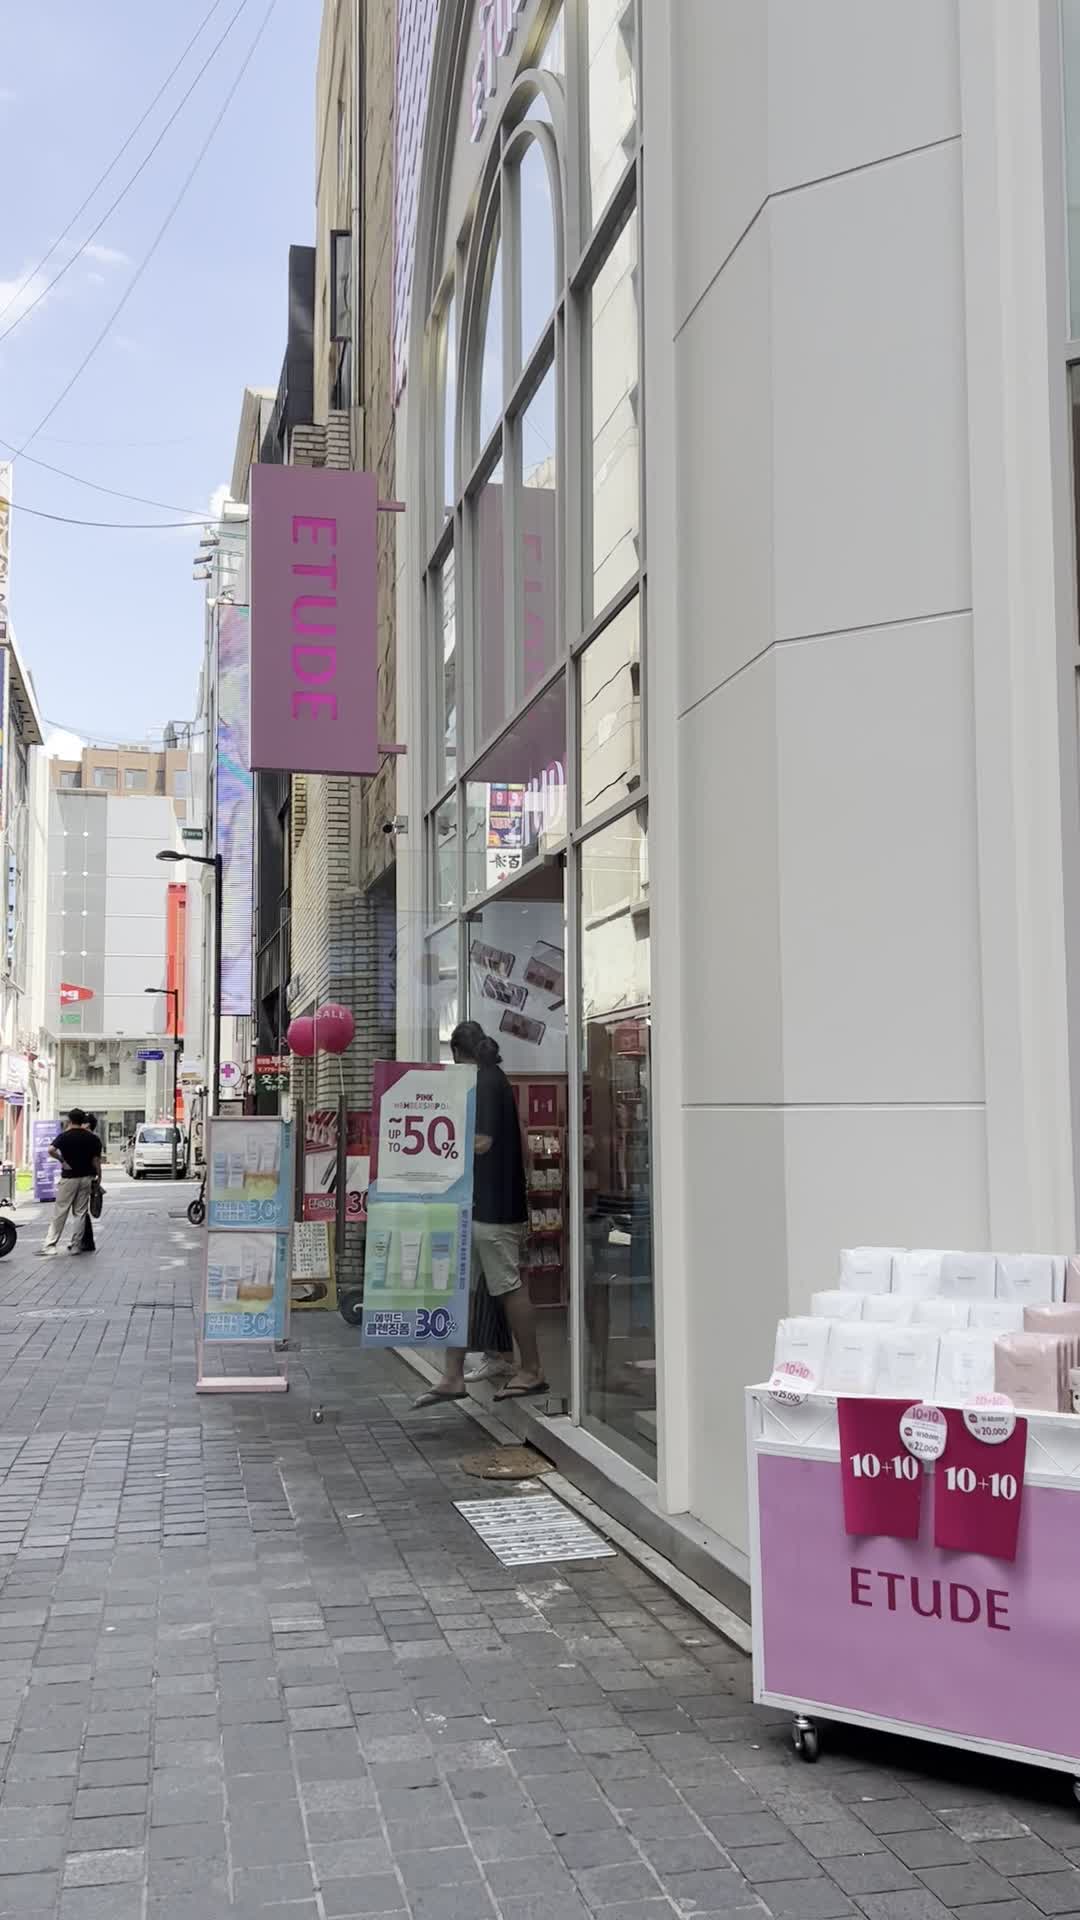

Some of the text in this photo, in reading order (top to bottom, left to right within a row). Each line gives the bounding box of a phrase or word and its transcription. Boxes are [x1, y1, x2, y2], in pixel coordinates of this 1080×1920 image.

[292, 515, 337, 720] ETUDE
[388, 1130, 401, 1139] UP
[388, 1142, 401, 1152] TO
[415, 1307, 457, 1338] 30%
[850, 1453, 919, 1481] 10+10
[943, 1466, 1018, 1500] 10+10
[850, 1566, 1012, 1632] ETUDE
